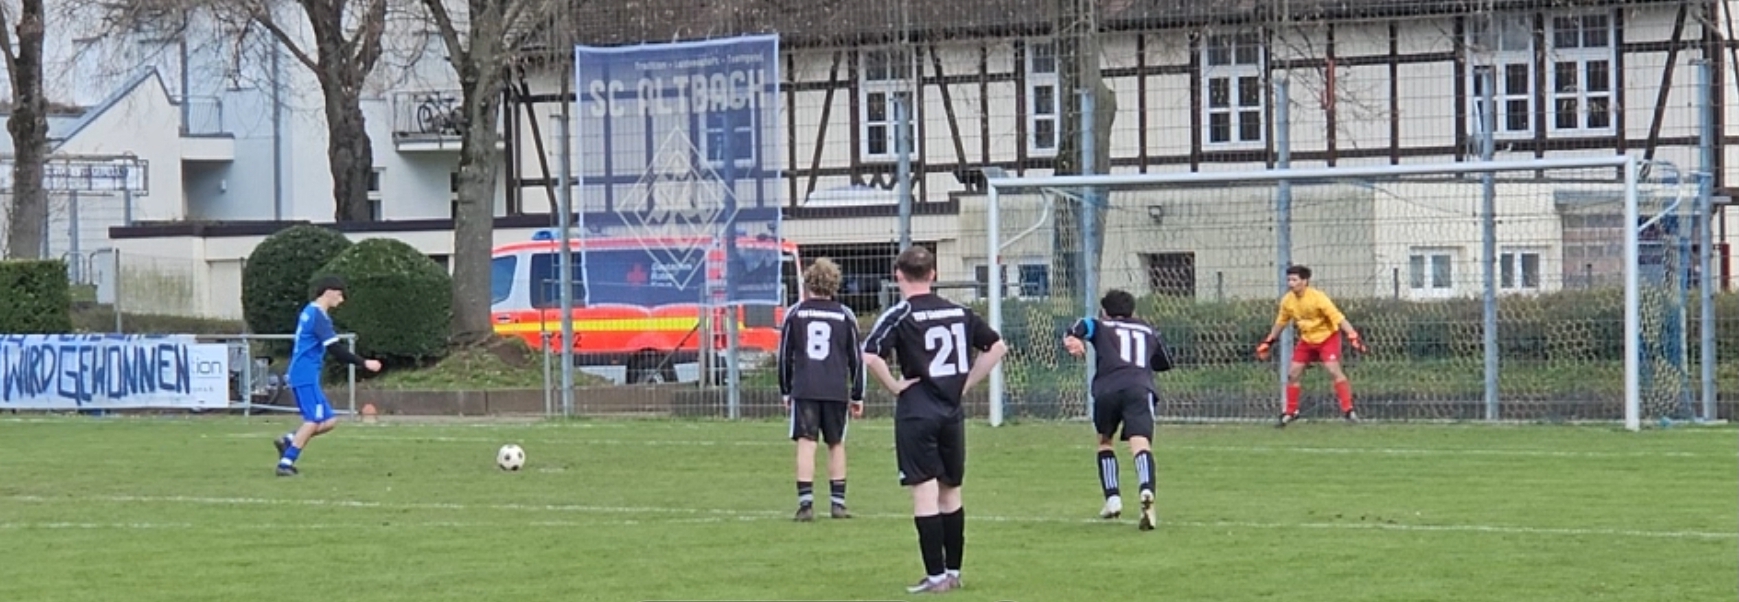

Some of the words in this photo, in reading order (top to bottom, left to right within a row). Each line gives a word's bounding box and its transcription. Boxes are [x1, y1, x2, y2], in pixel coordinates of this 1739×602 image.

[590, 79, 624, 117] SC
[638, 69, 765, 116] ALTBACH
[807, 321, 831, 360] 8
[925, 322, 969, 377] 21
[1115, 328, 1145, 368] 11
[3, 343, 57, 402] WIRD
[58, 344, 190, 406] GEWONNEN
